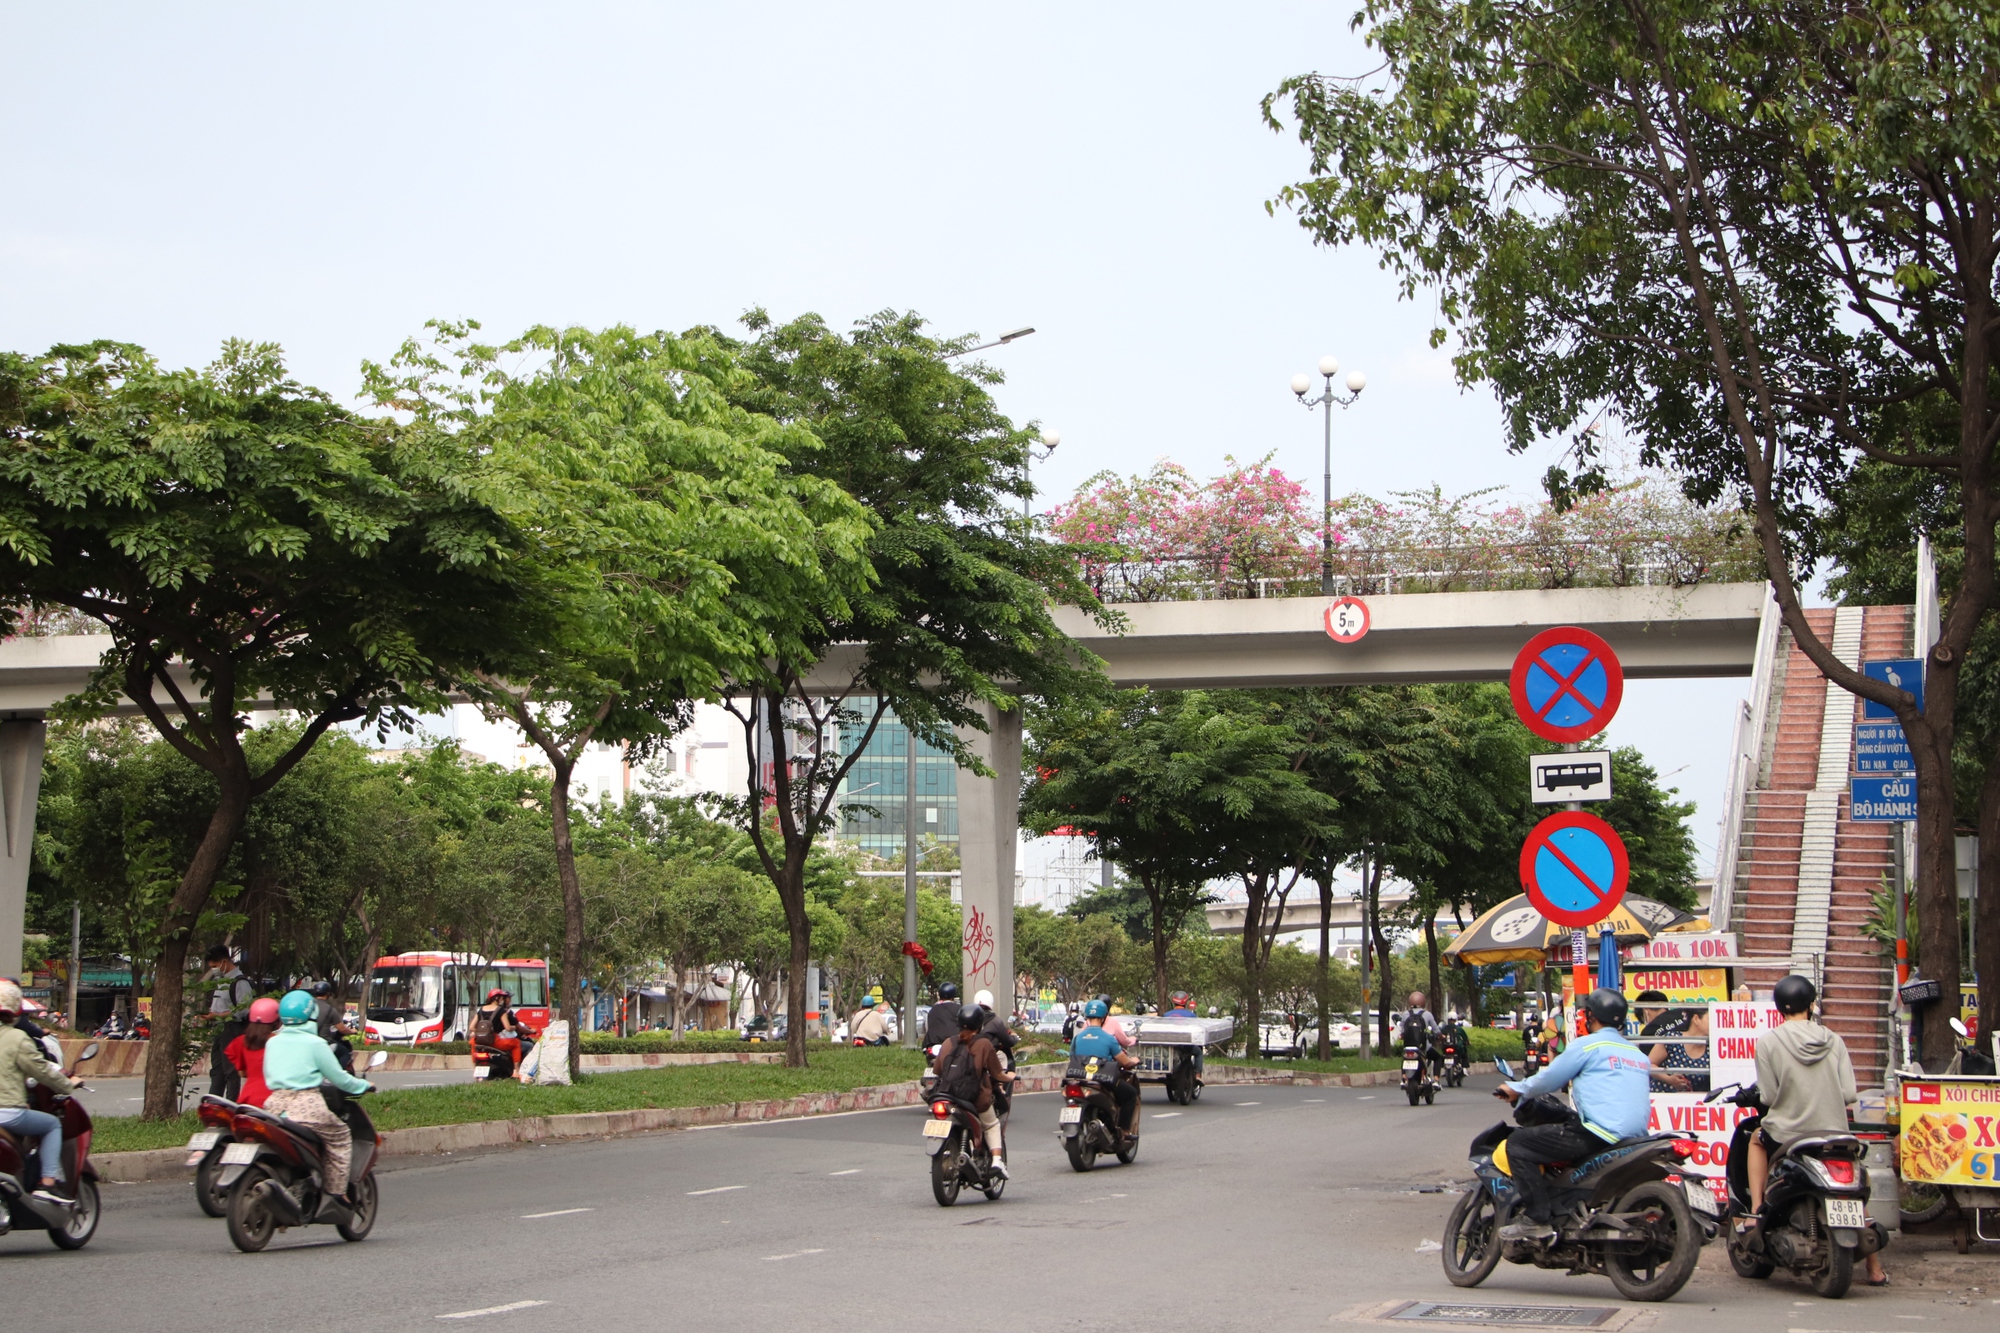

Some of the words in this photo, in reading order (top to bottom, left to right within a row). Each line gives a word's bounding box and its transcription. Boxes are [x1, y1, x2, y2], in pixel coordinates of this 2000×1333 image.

[1858, 727, 1877, 739] NGƯỜI
[1879, 730, 1885, 738] ĐI
[1887, 727, 1897, 740] BỘ
[1874, 741, 1886, 753] CẦU
[1886, 744, 1904, 755] VƯỢT
[1861, 760, 1871, 769] TAI
[1873, 760, 1887, 772] NẠN
[1893, 760, 1909, 770] GIAO
[1882, 779, 1910, 797] CẦU
[1853, 800, 1872, 818] BỘ
[1873, 799, 1911, 816] HÀNH
[1641, 941, 1682, 959] 10k
[1689, 939, 1731, 958] 10k
[1633, 970, 1699, 990] CHANH
[1715, 1005, 1735, 1028] TRÀ
[1737, 1003, 1757, 1029] TẮC
[1717, 1037, 1758, 1059] CHAN
[1945, 1084, 1968, 1102] XÔI
[1970, 1085, 2000, 1103] CHIÊ
[1667, 1100, 1726, 1131] VIÊN
[1831, 1201, 1859, 1213] 48-B1
[1829, 1213, 1864, 1226] 598.61
